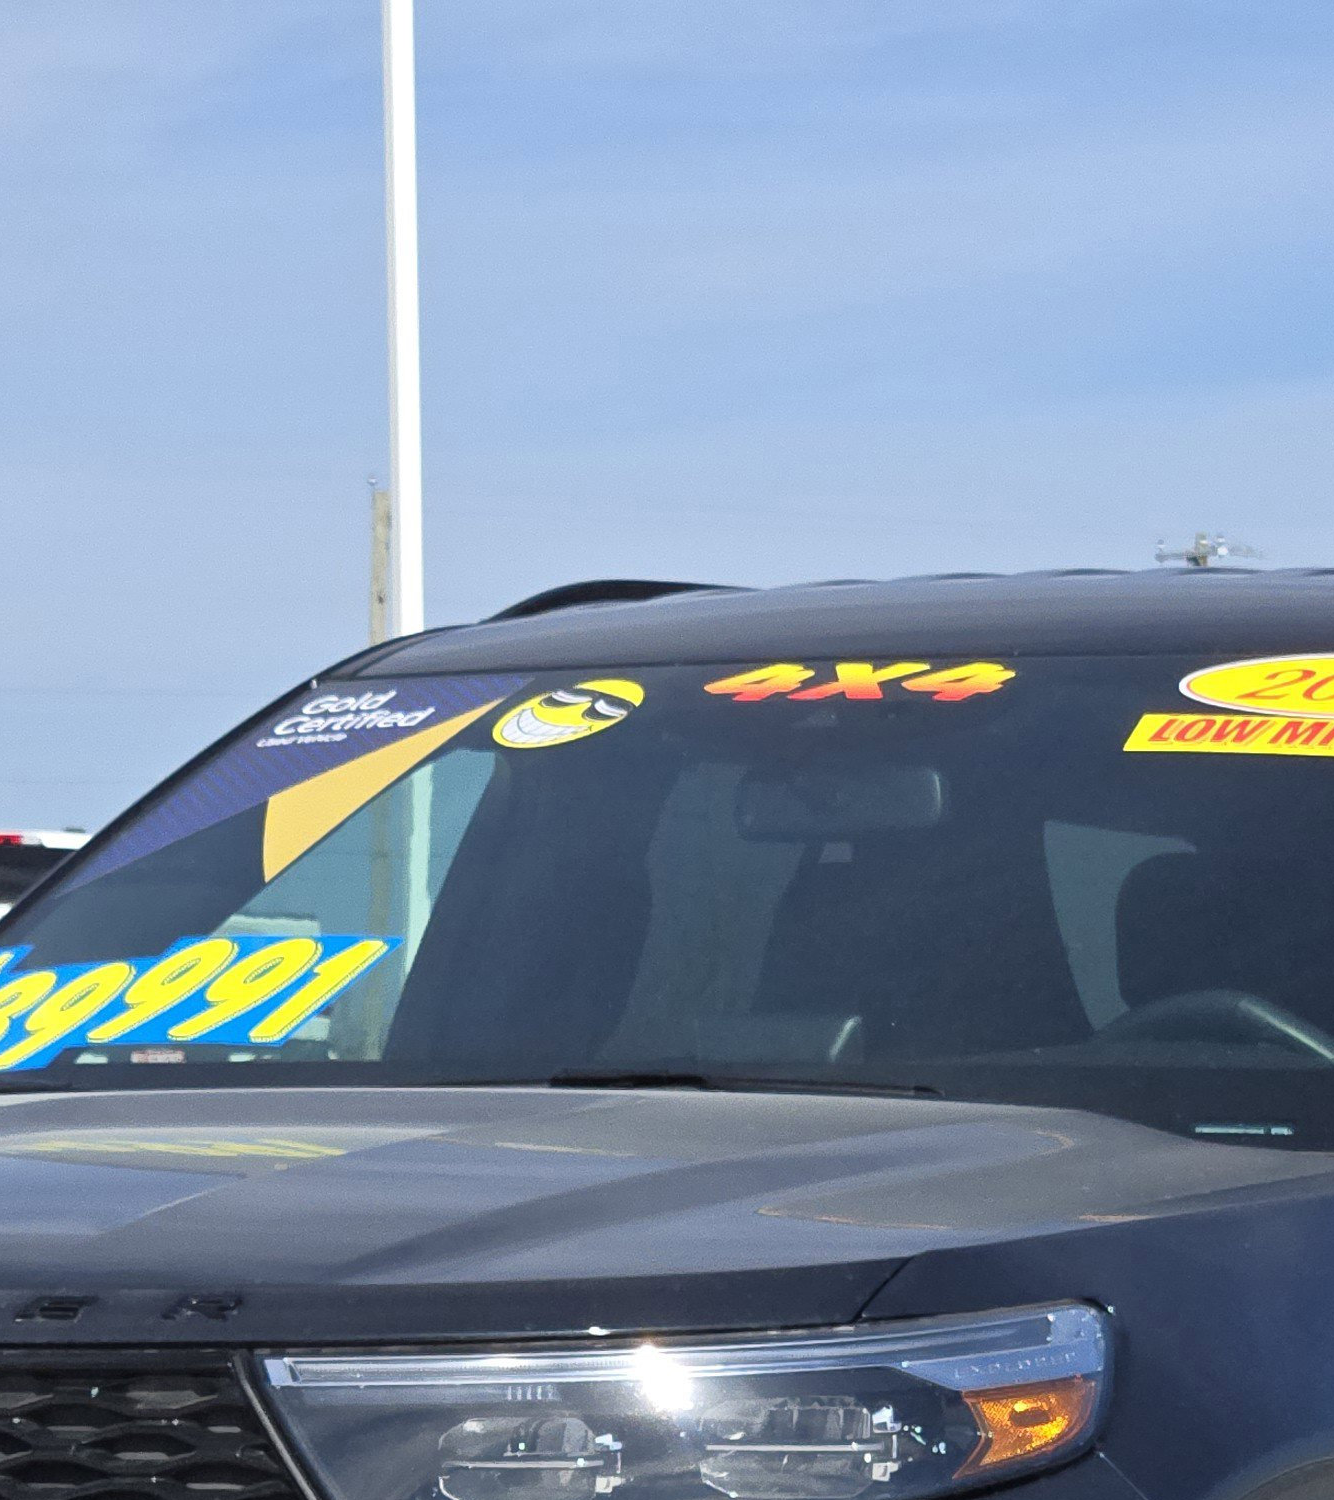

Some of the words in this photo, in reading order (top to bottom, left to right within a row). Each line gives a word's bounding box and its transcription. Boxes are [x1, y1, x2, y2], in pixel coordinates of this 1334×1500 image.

[302, 689, 397, 714] Gold
[273, 706, 435, 736] Certified
[1147, 718, 1270, 743] LOW
